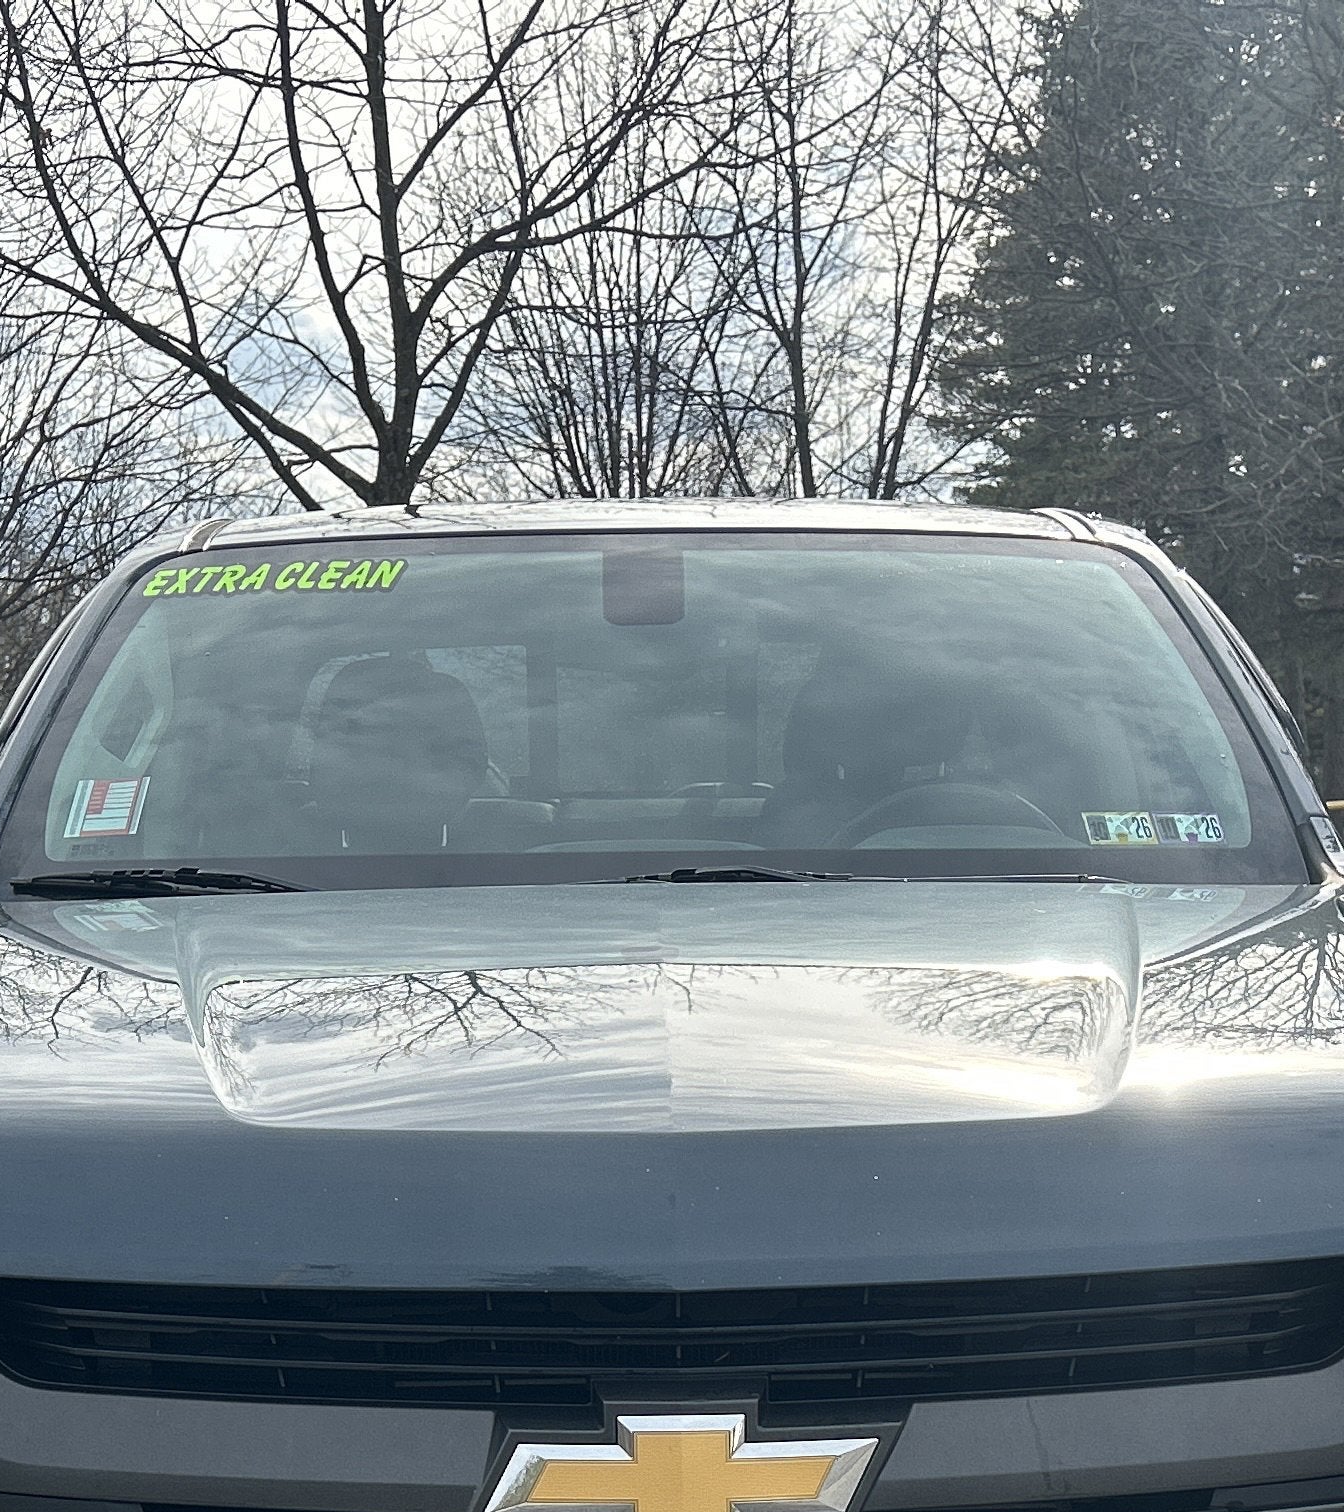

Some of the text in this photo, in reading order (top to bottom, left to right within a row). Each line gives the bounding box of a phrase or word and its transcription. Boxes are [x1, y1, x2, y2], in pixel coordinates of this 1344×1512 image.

[143, 560, 404, 596] EXTRA CLEAN
[1131, 816, 1153, 839] 26
[1201, 816, 1222, 839] 26
